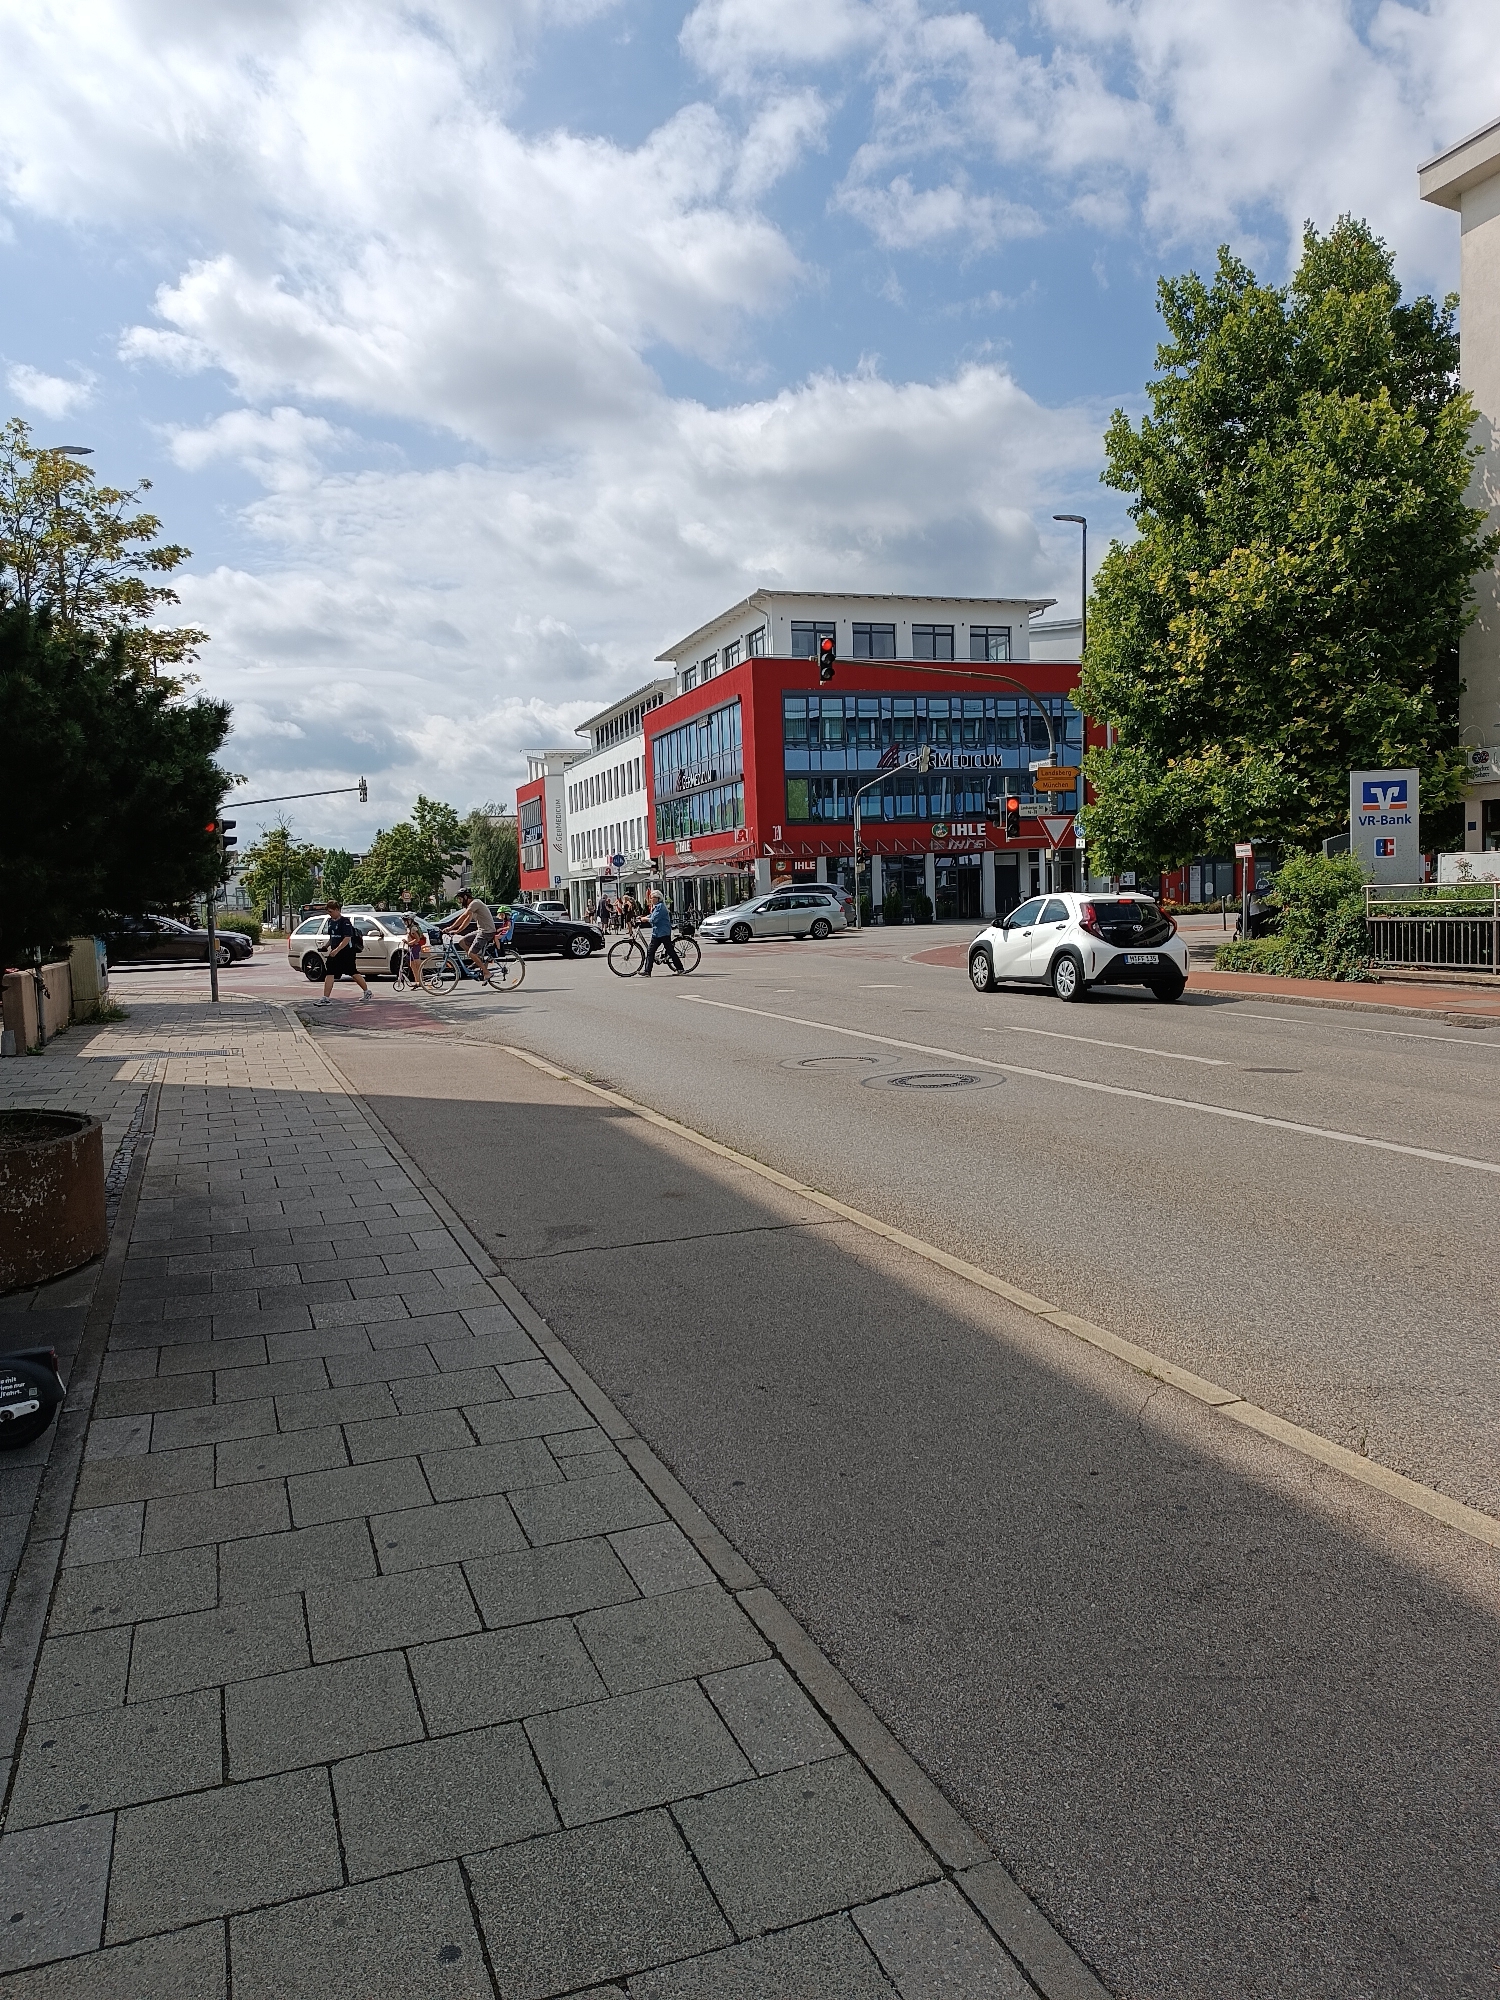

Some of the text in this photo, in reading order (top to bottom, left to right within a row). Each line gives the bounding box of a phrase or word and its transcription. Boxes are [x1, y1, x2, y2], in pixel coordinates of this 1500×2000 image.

[907, 752, 1003, 768] GRMEDICUM
[1358, 813, 1412, 827] VR-Bank
[951, 822, 987, 837] IHLE
[794, 861, 816, 870] IHLE
